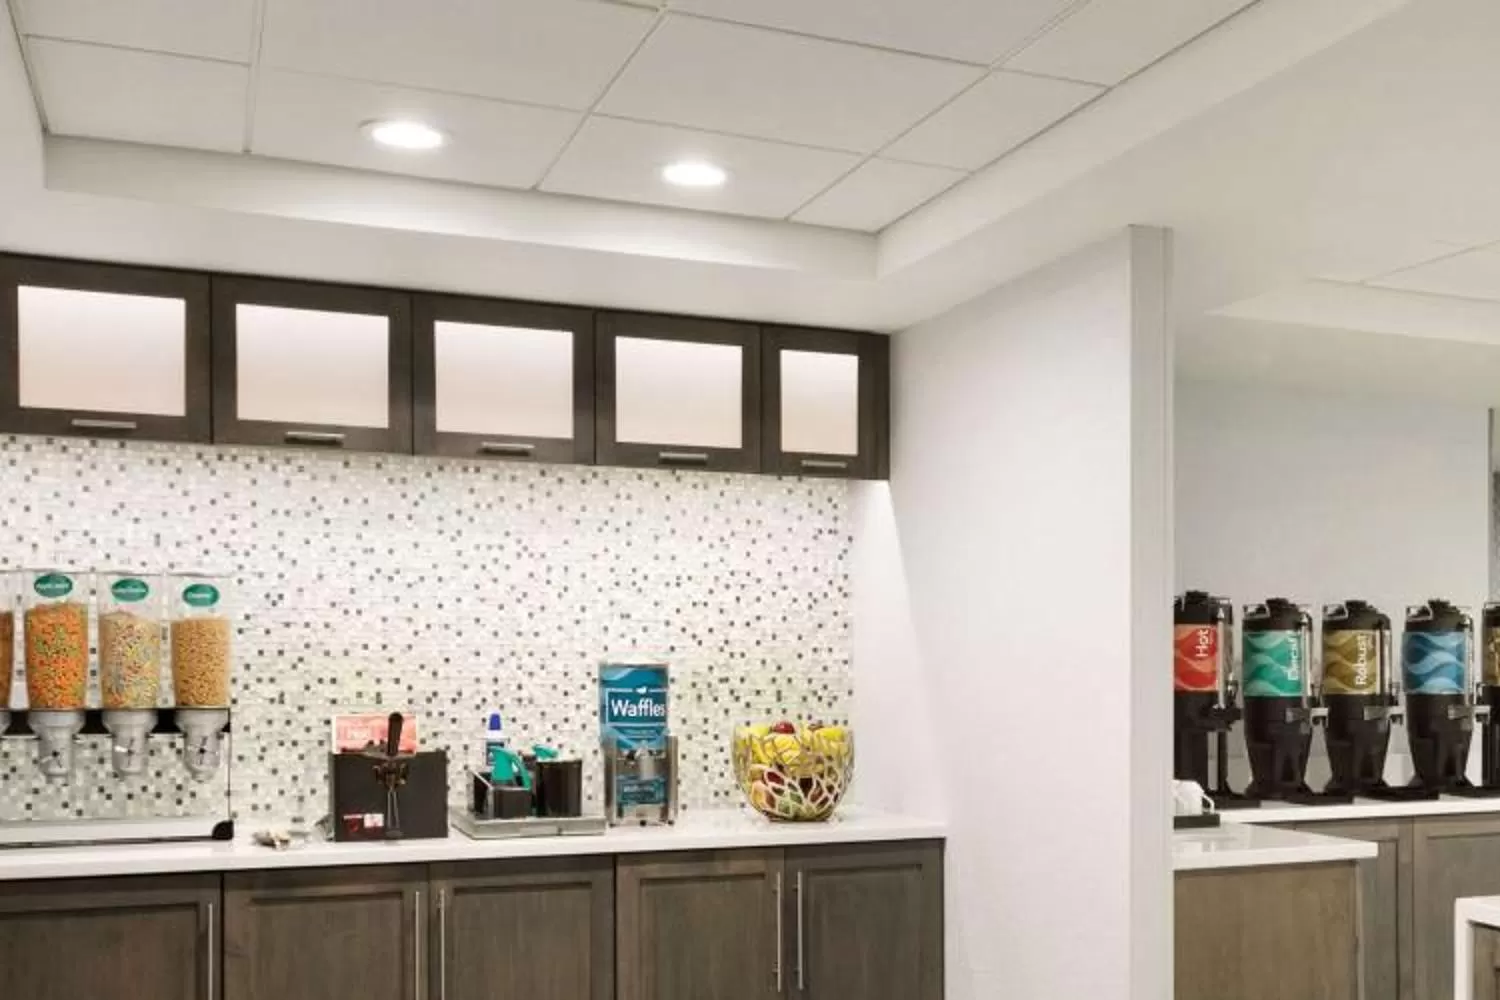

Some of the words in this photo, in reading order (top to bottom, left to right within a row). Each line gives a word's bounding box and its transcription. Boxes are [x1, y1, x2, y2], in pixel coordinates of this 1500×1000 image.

[1195, 627, 1209, 657] Hot
[1354, 634, 1367, 685] Robust
[611, 698, 665, 718] Waffles
